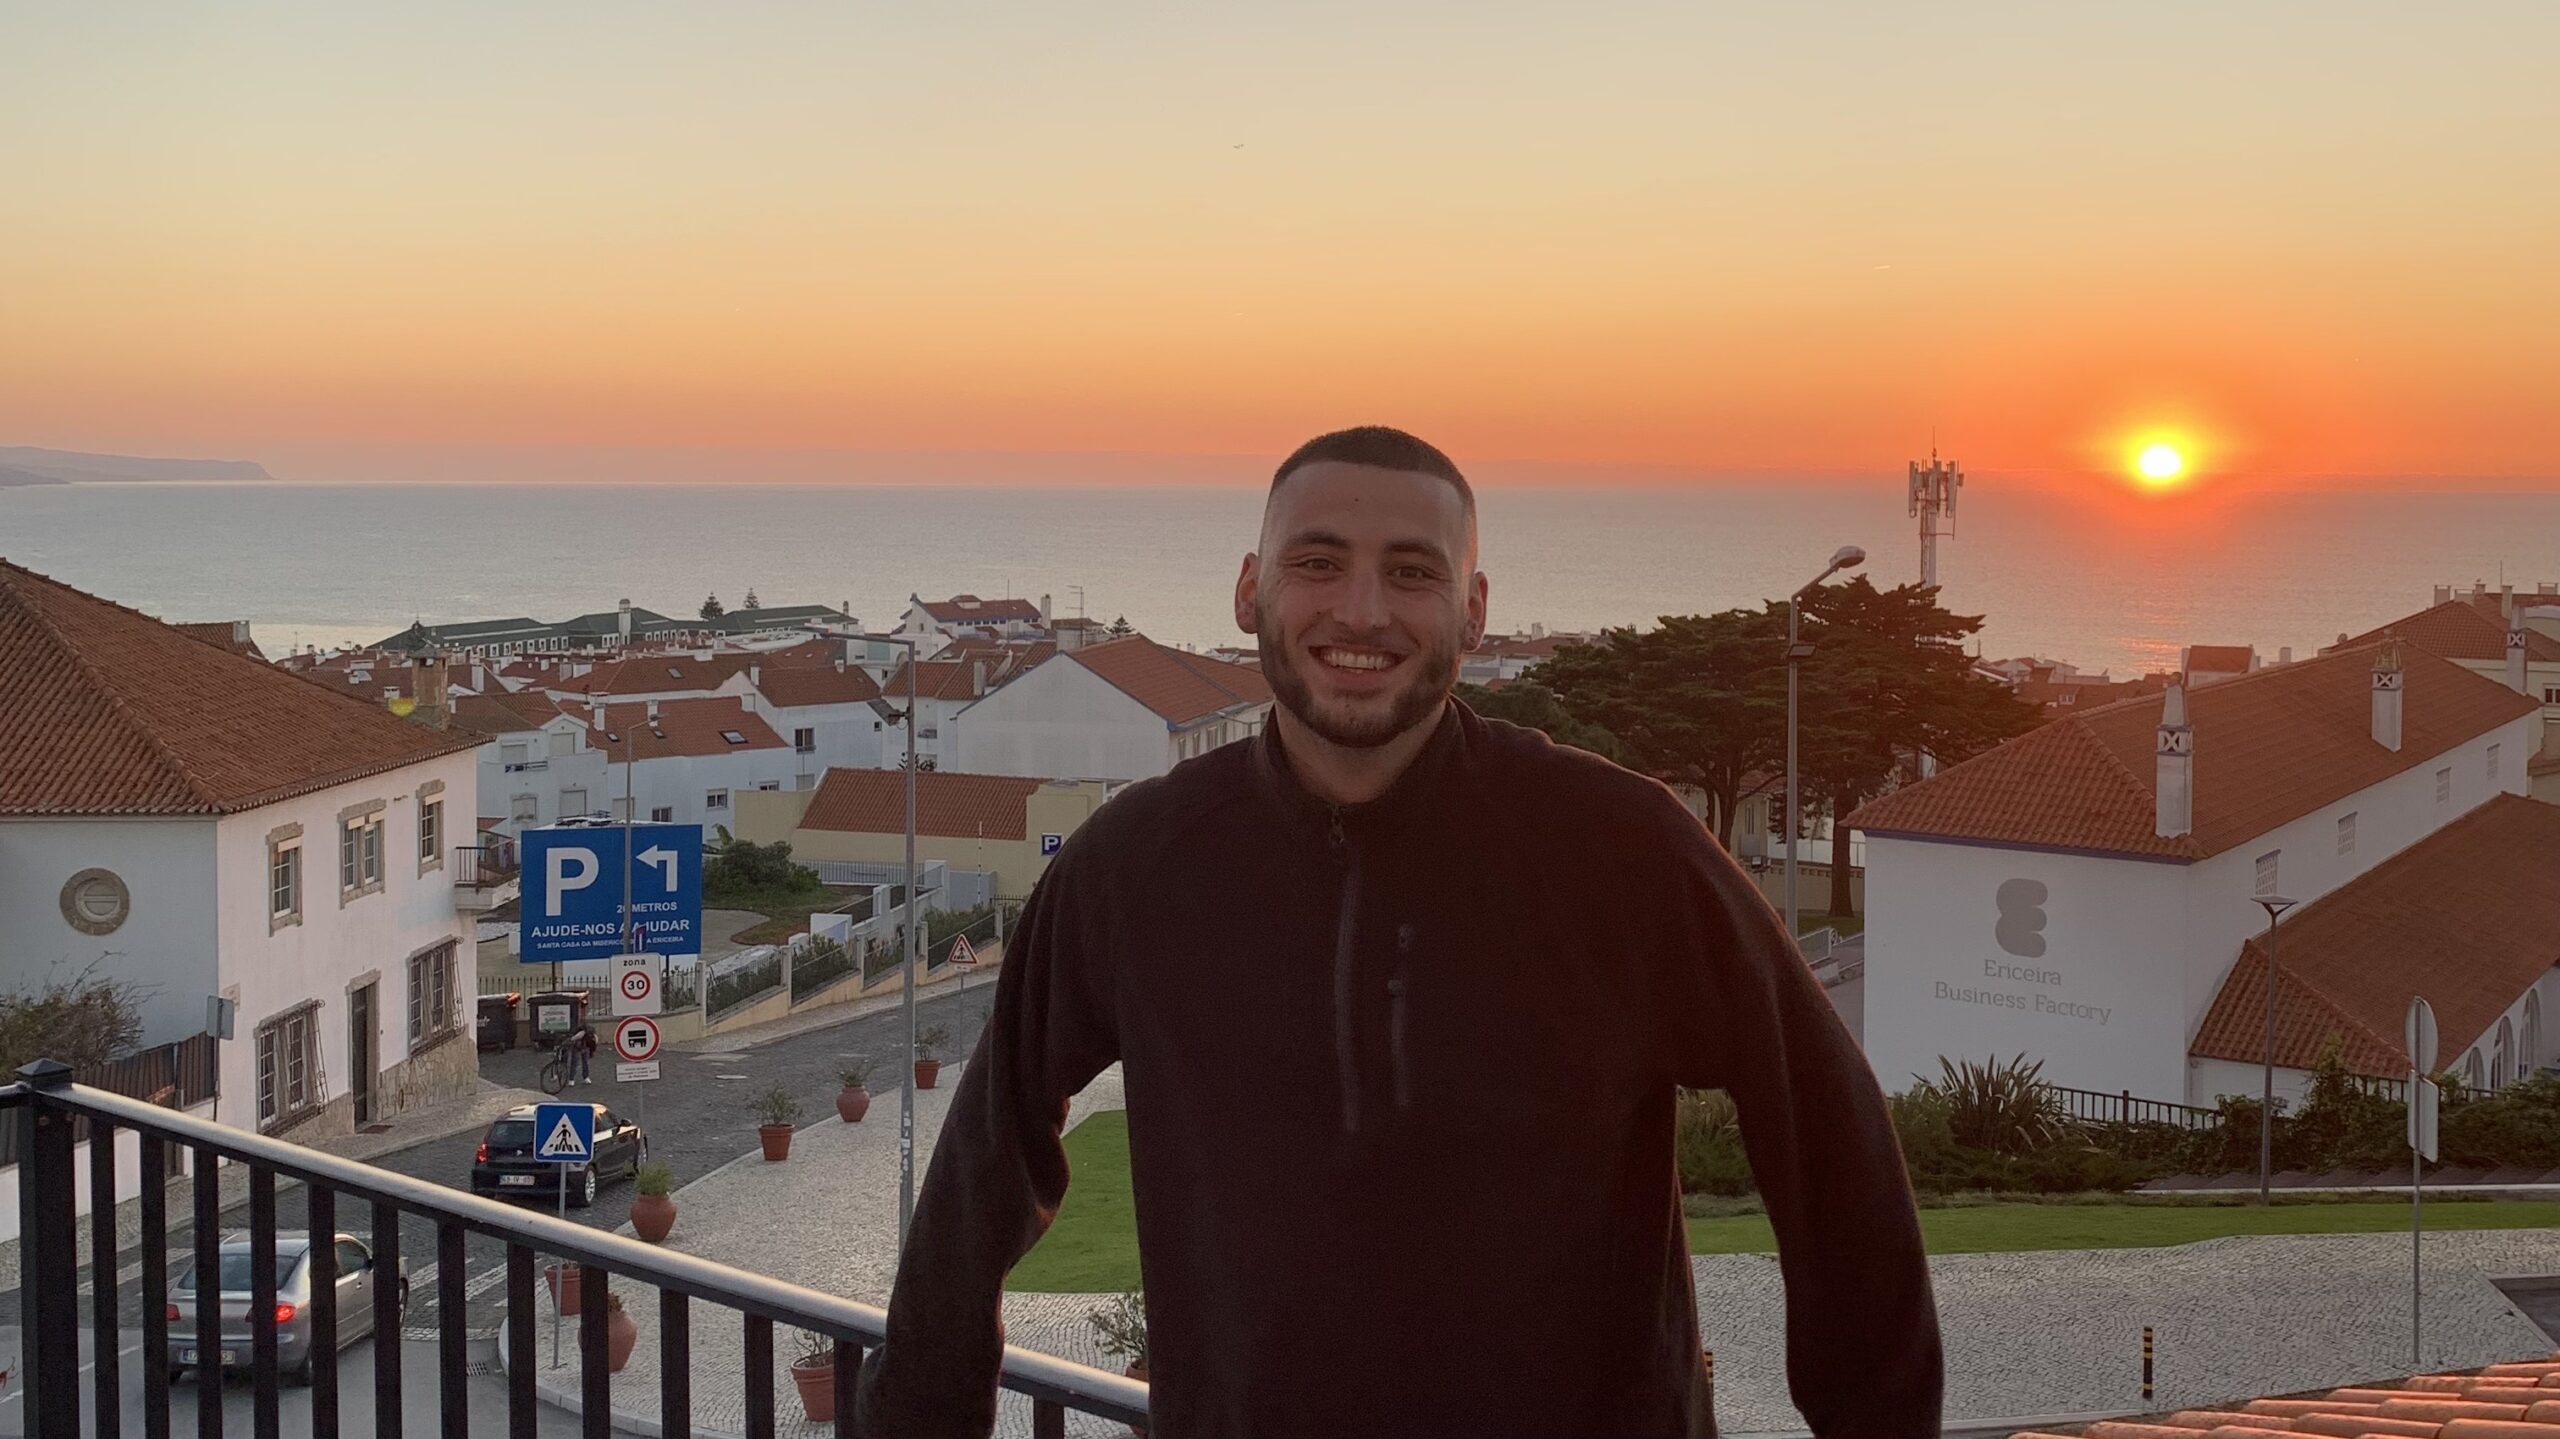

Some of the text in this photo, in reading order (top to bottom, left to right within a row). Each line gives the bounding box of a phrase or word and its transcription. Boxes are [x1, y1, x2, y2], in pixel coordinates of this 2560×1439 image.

[1044, 836, 1059, 850] P
[546, 847, 599, 917] P
[632, 901, 678, 913] METROS
[531, 923, 616, 938] AJUDE-NOS
[623, 958, 646, 966] zona
[1983, 959, 2062, 985] Ericeira
[627, 980, 645, 990] 30
[1935, 981, 2112, 1025] Business Factory
